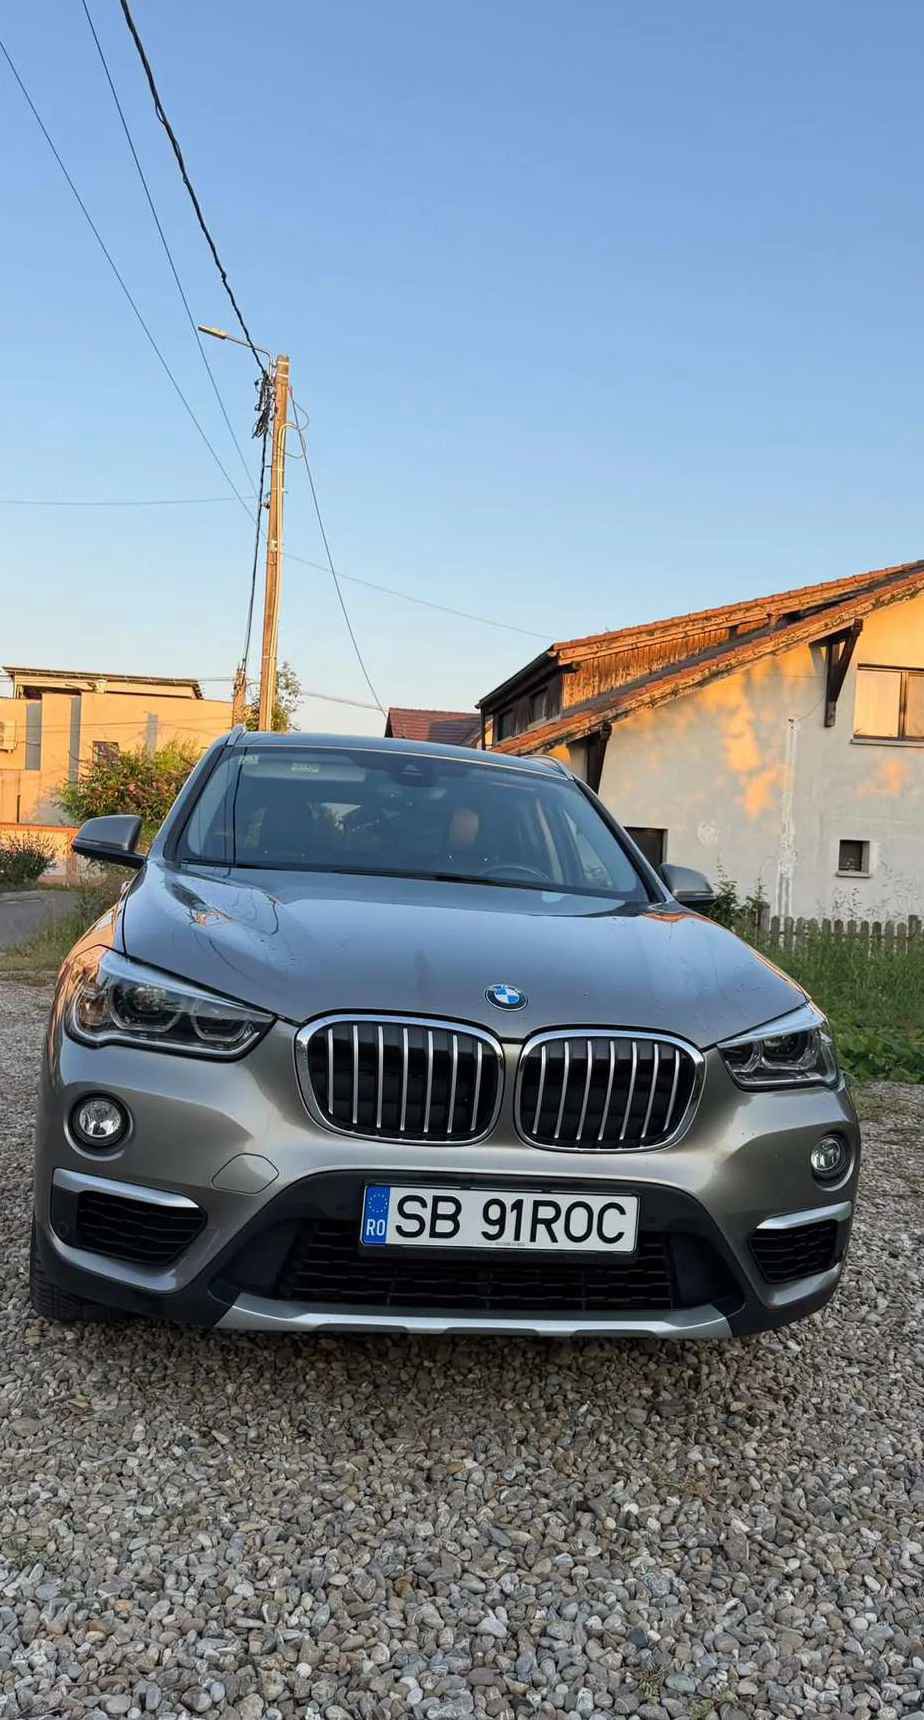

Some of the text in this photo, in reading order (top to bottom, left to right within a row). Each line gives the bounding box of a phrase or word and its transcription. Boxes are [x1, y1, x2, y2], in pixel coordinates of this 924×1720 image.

[366, 1219, 386, 1236] RO
[395, 1194, 627, 1244] SB 91ROC
